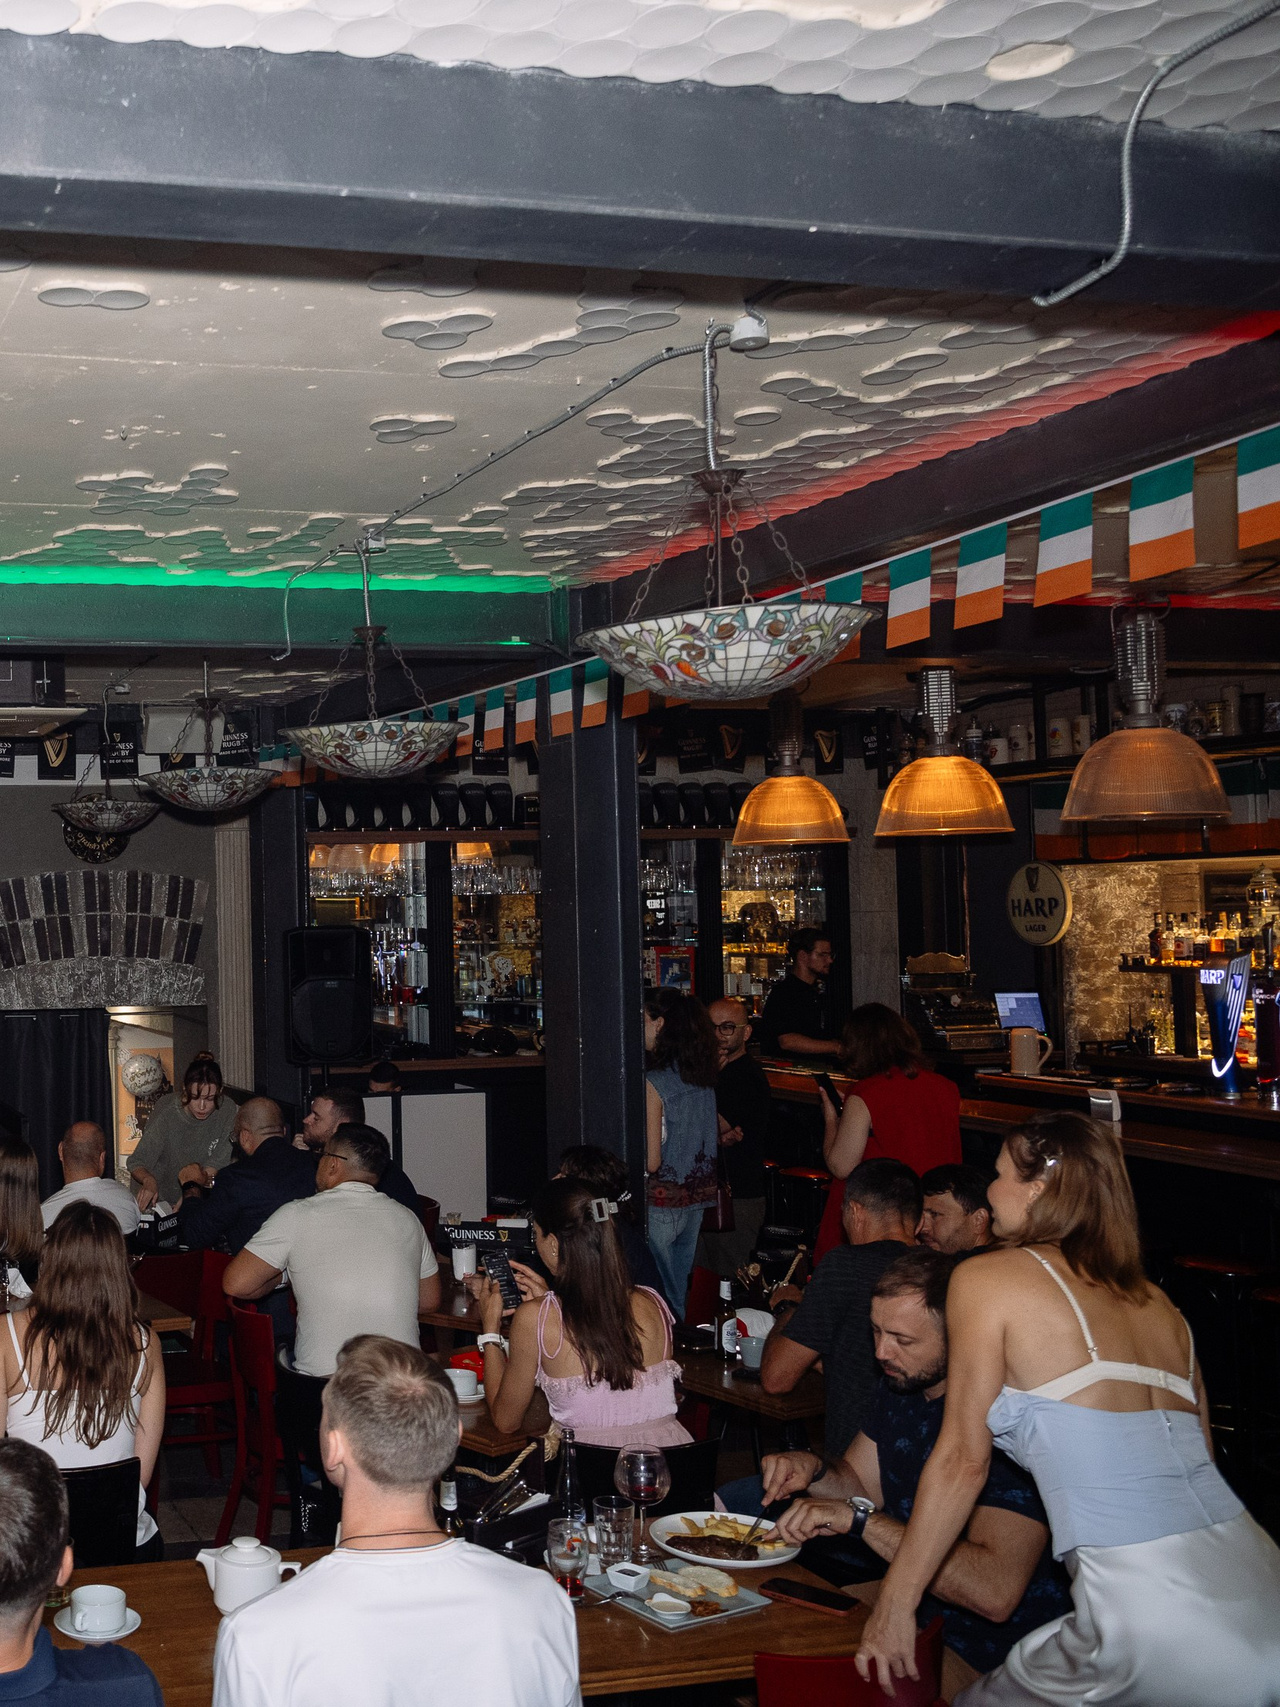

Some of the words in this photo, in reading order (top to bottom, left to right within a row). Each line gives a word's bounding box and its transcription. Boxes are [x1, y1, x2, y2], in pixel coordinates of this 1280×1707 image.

[1010, 897, 1060, 918] HARP
[1199, 969, 1225, 984] HARP
[447, 1227, 496, 1240] GUINNESS
